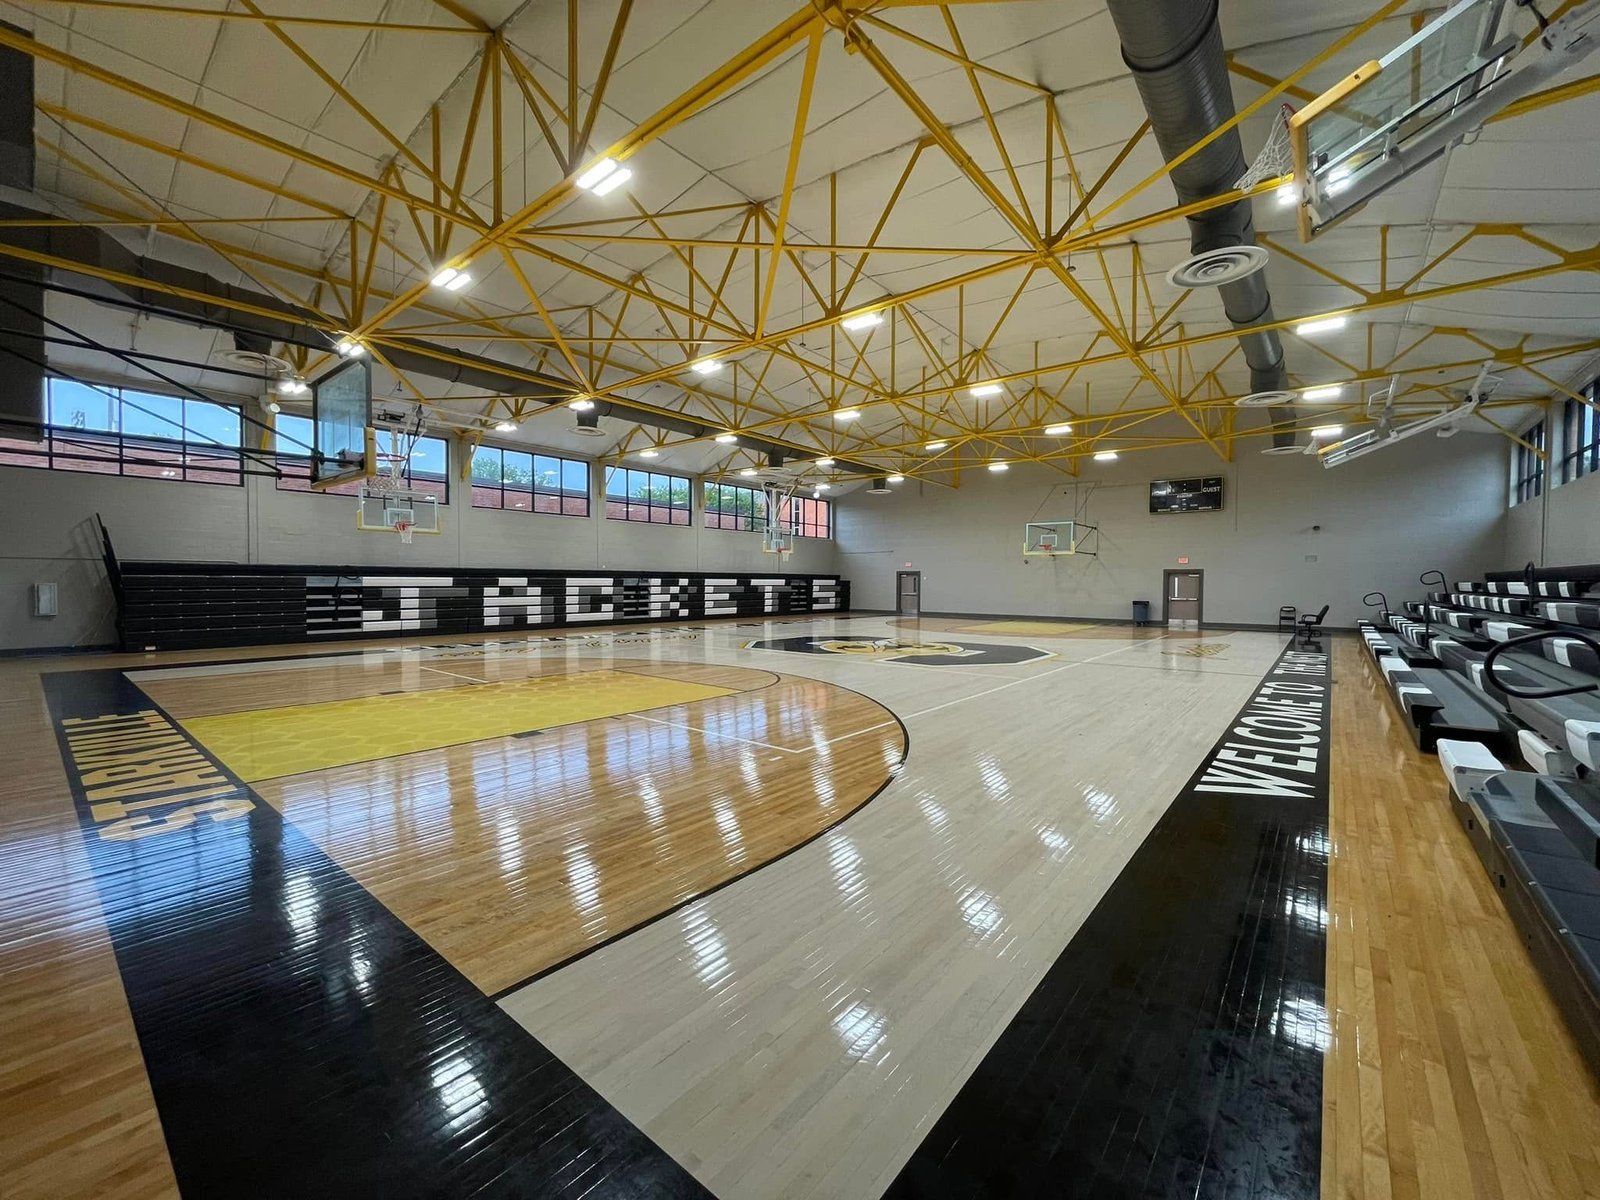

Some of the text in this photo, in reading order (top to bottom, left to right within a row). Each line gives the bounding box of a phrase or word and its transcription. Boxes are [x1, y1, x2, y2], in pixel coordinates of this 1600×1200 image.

[362, 576, 838, 632] JACKETS
[1259, 681, 1325, 697] TO
[1273, 662, 1327, 676] THE
[61, 709, 257, 841] STARKVILLE
[1193, 697, 1323, 798] WELCOME
